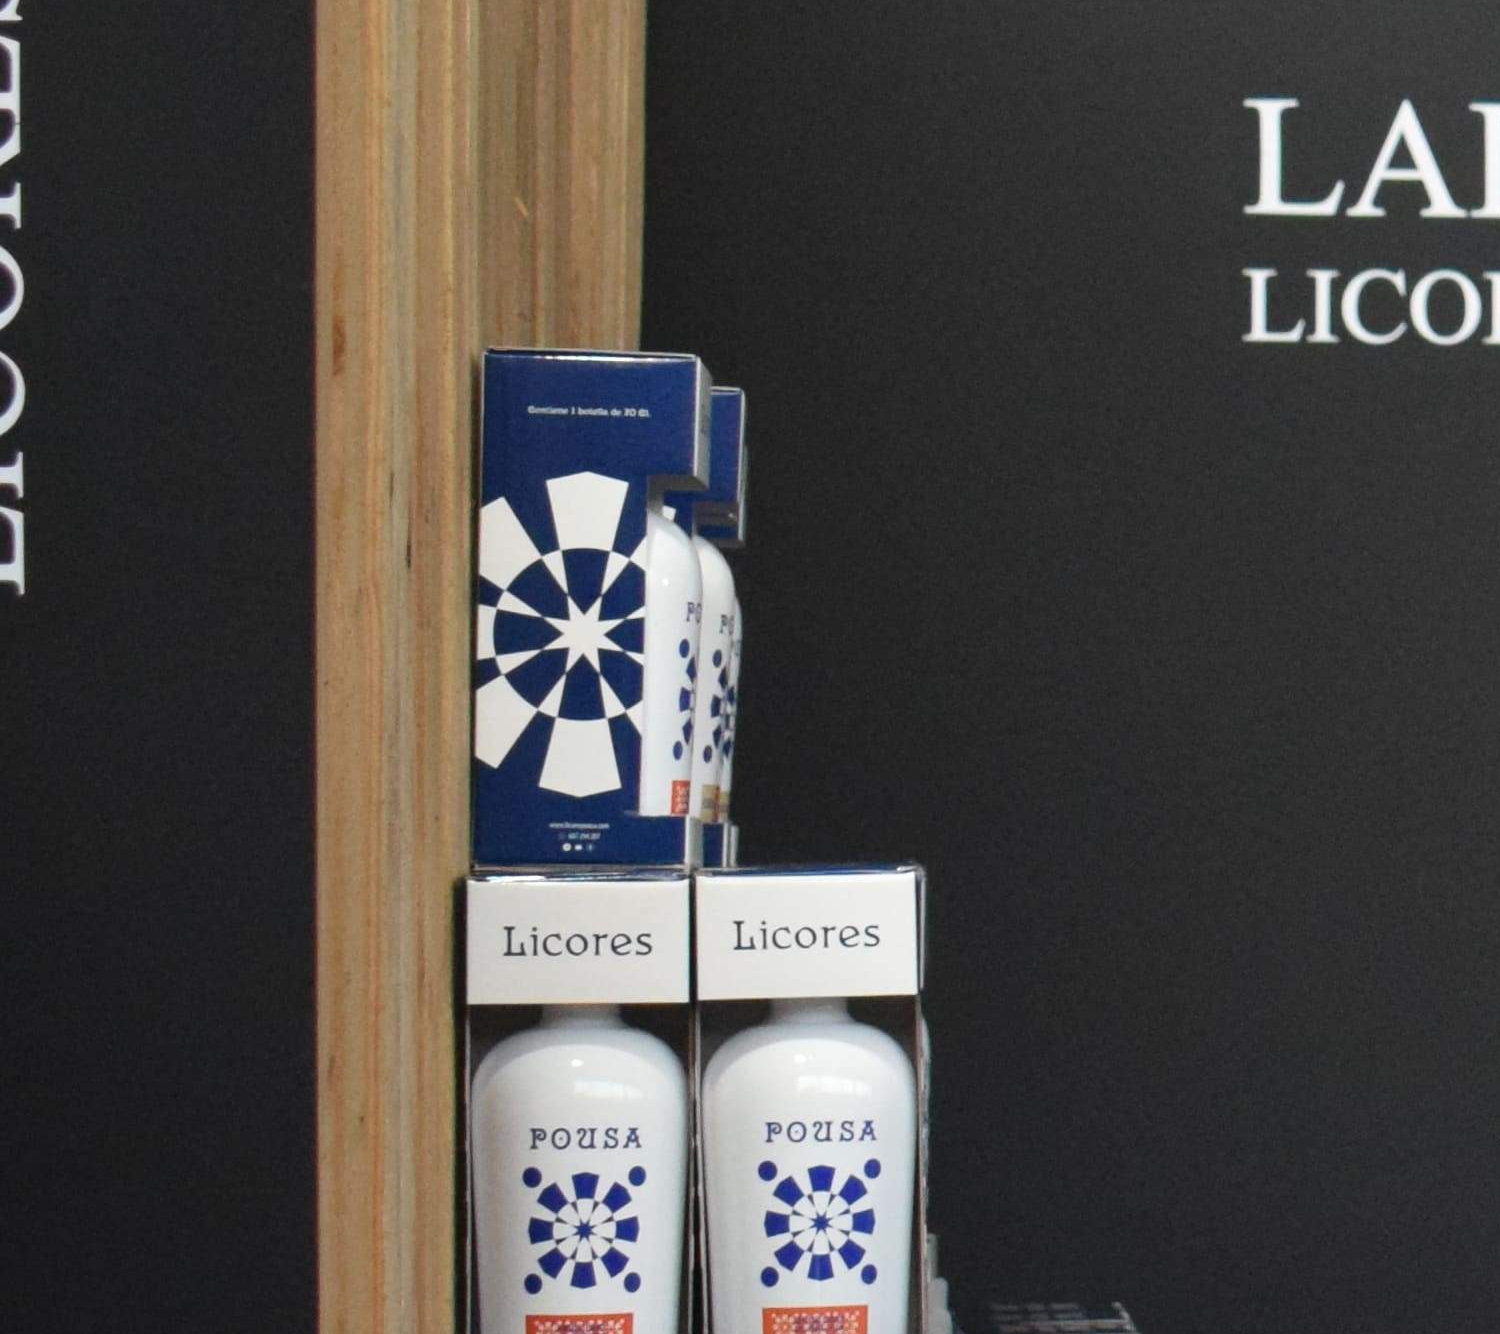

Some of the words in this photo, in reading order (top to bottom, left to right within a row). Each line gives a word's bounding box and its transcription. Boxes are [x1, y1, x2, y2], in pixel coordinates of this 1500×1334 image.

[503, 925, 653, 957] Licores
[733, 920, 881, 952] Licores
[530, 1127, 643, 1151] POUSA
[765, 1120, 878, 1143] POUSA
